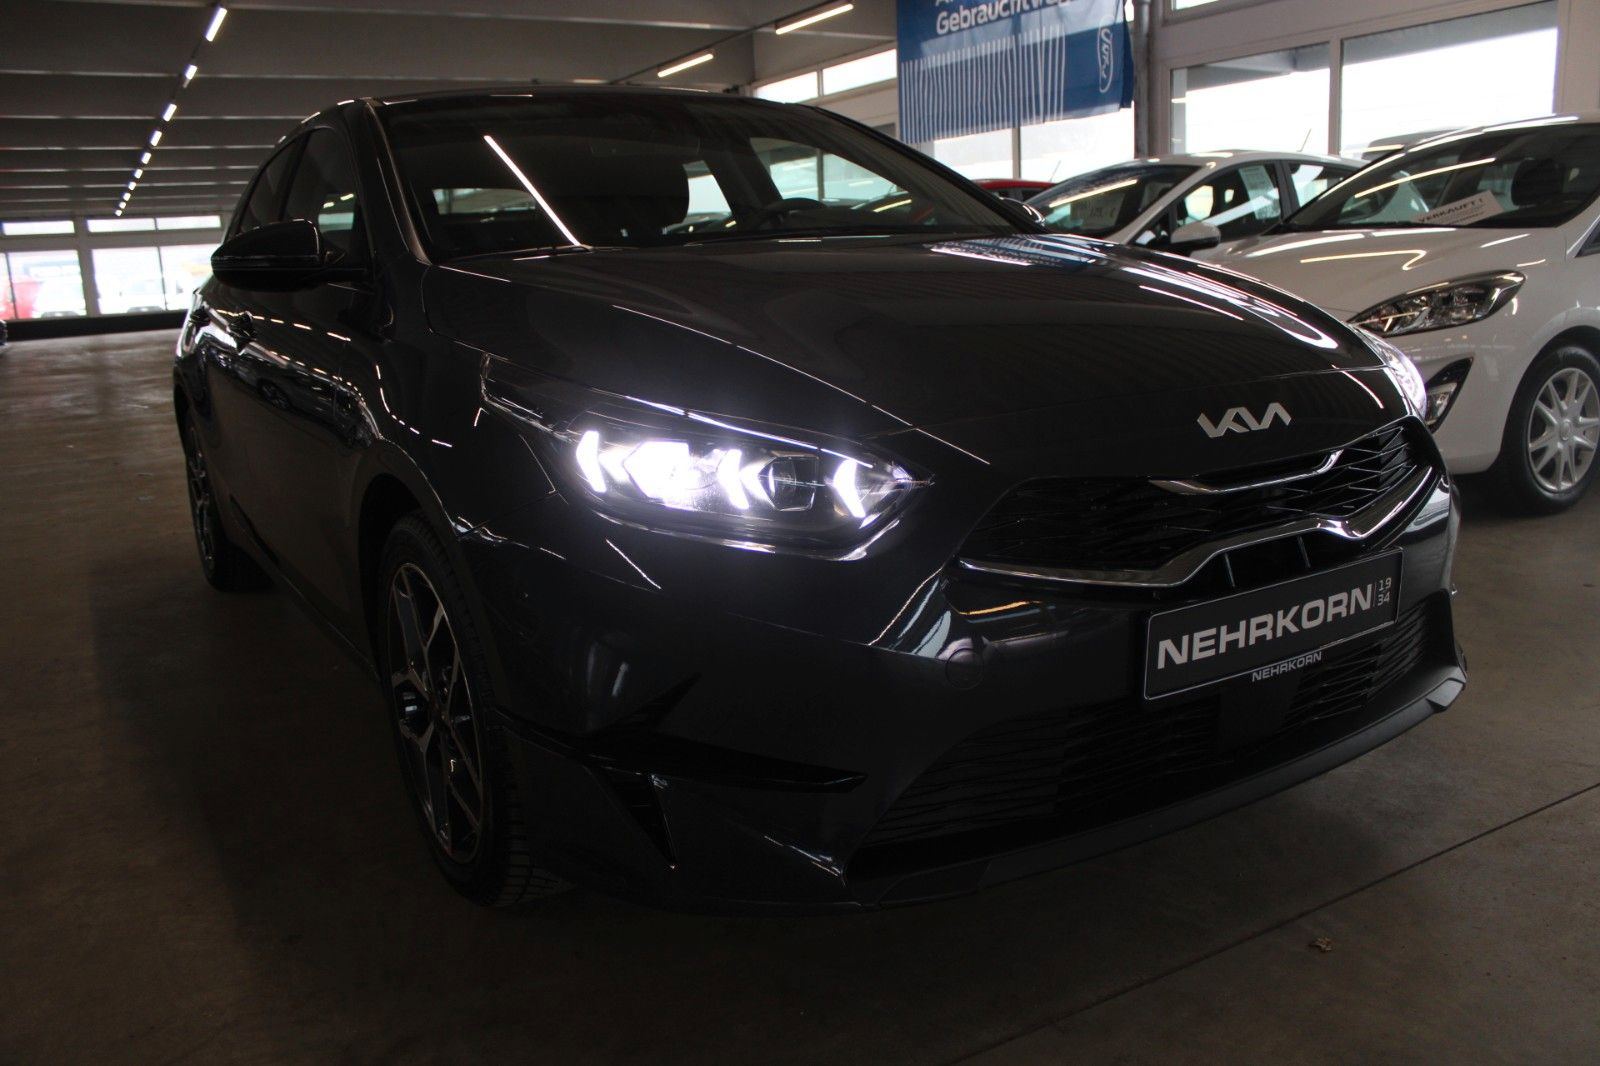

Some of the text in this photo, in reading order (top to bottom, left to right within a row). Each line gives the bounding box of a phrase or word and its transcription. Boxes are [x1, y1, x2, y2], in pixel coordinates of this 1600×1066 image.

[1197, 402, 1292, 438] KIA
[1377, 591, 1391, 606] 34
[1378, 577, 1392, 591] 19
[1157, 584, 1373, 669] NEHRKORN
[1251, 651, 1322, 683] NEHRKORN
